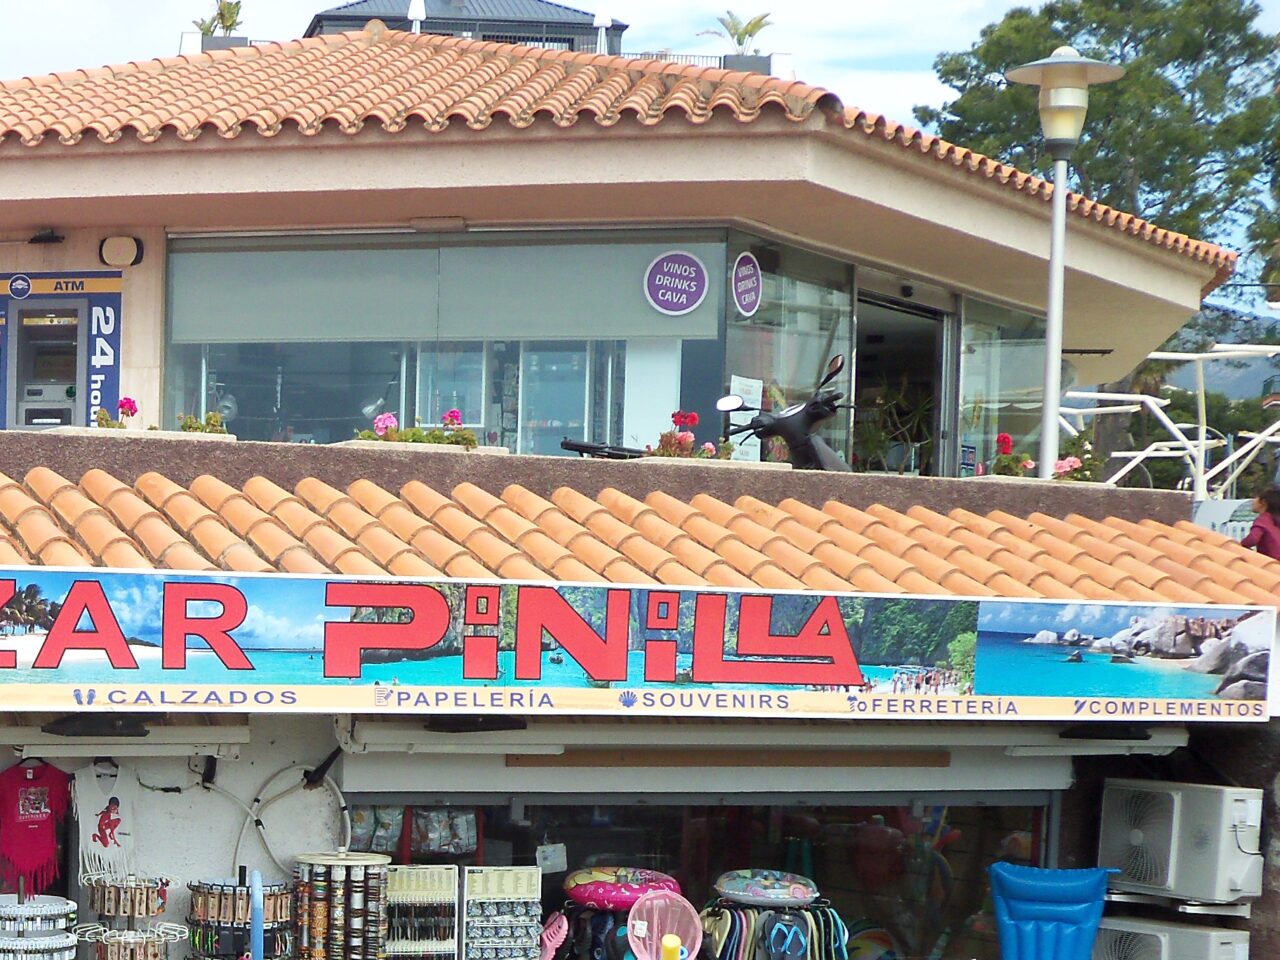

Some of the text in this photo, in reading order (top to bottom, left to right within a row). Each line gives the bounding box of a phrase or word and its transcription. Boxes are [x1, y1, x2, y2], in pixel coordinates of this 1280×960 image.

[663, 262, 696, 277] VINOS
[54, 280, 85, 291] ATM
[655, 274, 698, 292] DRINKS
[658, 289, 687, 305] CAVA
[91, 306, 115, 369] 24
[107, 689, 298, 706] CALZADOS
[396, 689, 555, 709] PAPELERÍA
[641, 691, 791, 711] SOUVENIRS
[871, 694, 1019, 716] FERRETERÍA
[1088, 699, 1265, 718] COMPLEMENTOS
